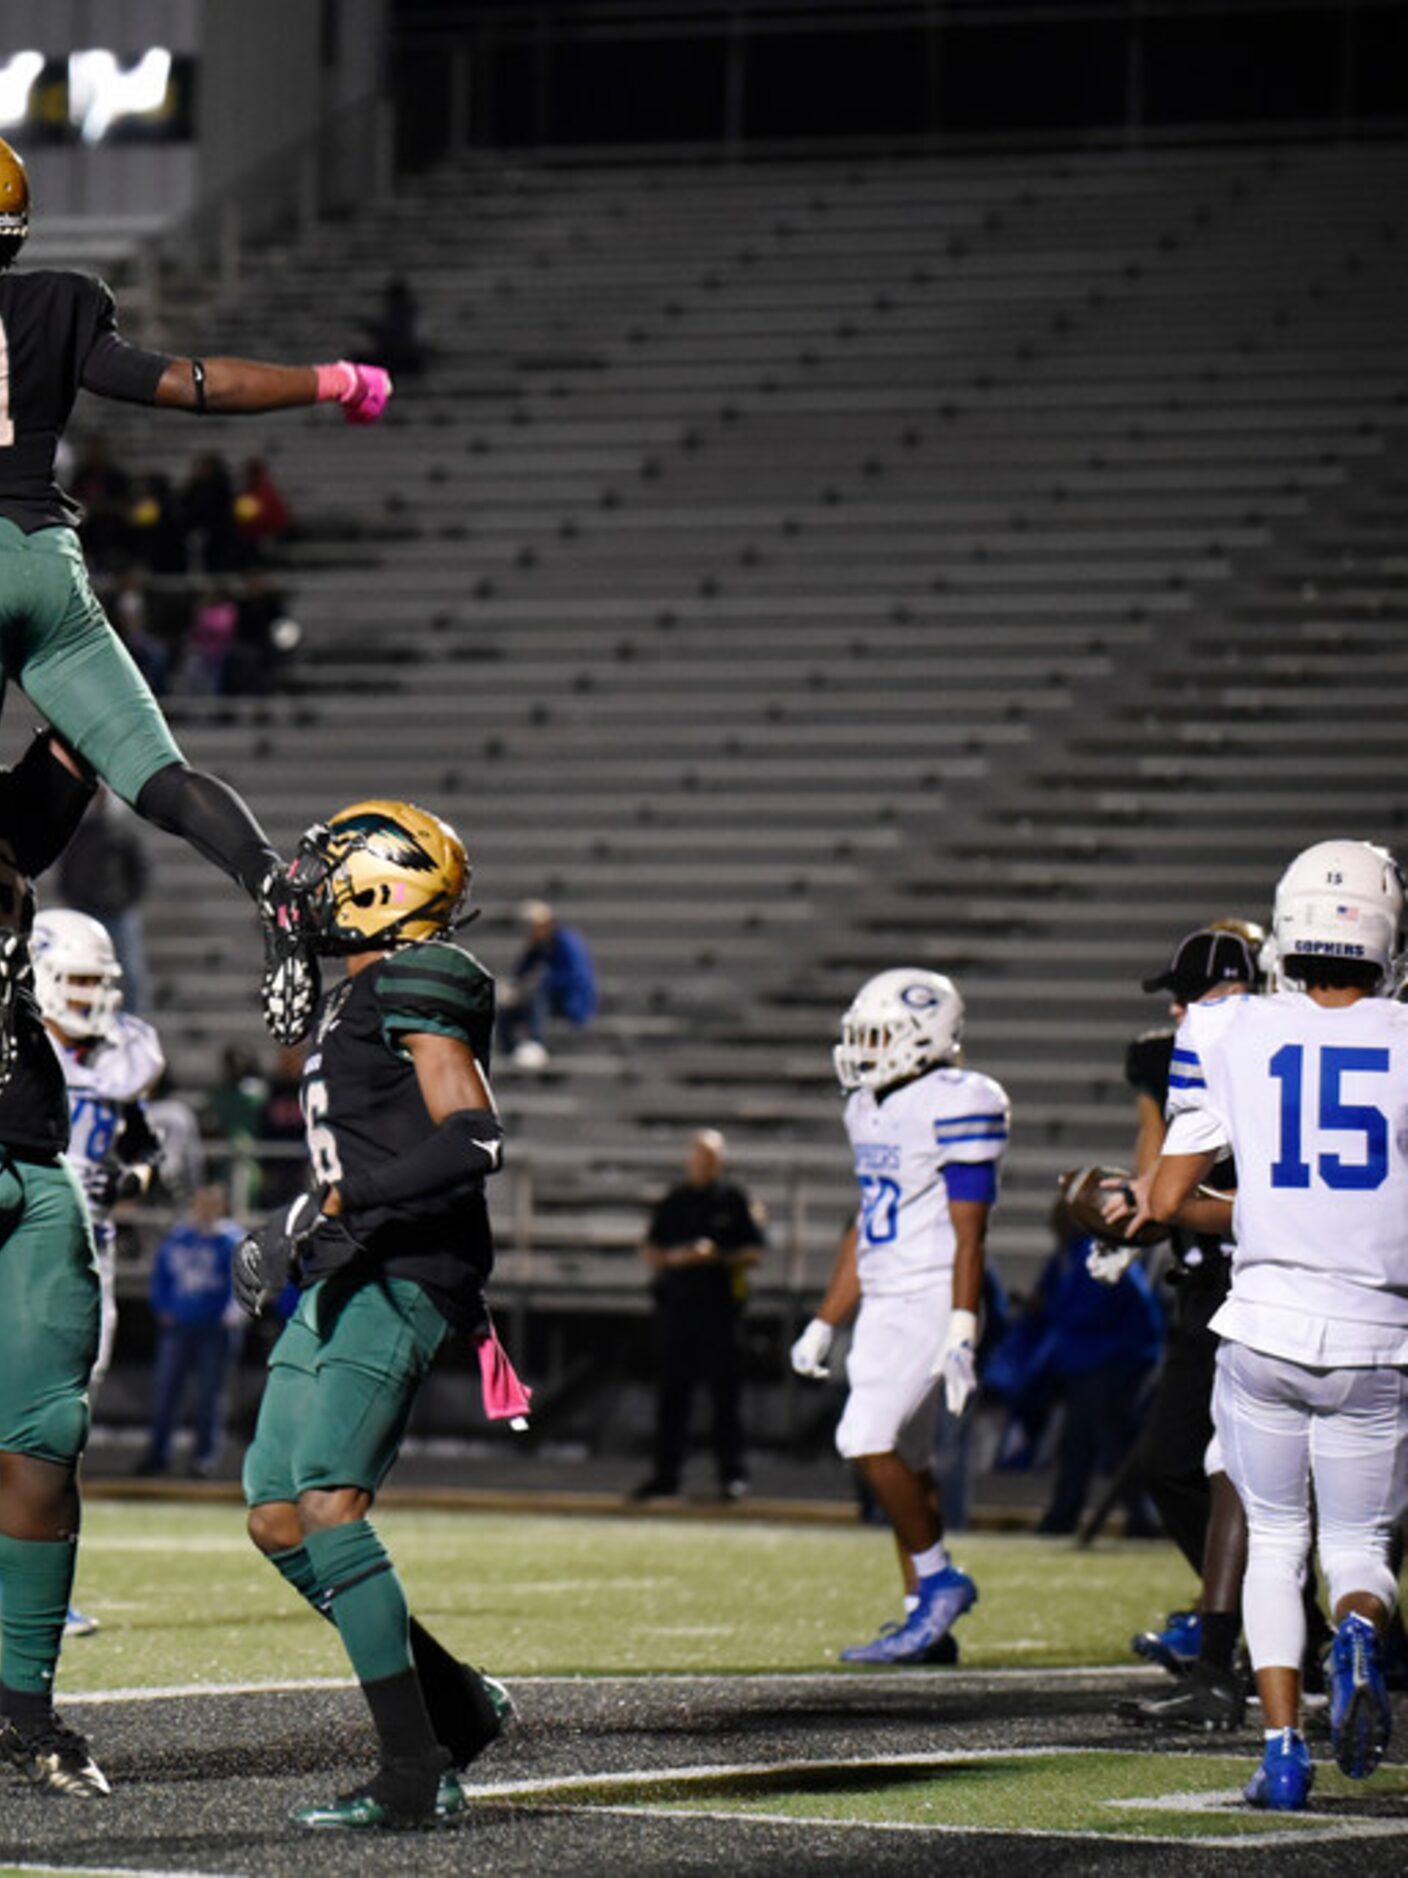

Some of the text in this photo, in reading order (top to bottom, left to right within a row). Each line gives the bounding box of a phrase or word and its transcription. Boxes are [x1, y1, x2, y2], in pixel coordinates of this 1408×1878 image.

[1326, 871, 1343, 885] 15
[1295, 939, 1365, 956] GOPHERS
[300, 1080, 344, 1186] 6
[1269, 1044, 1390, 1190] 15
